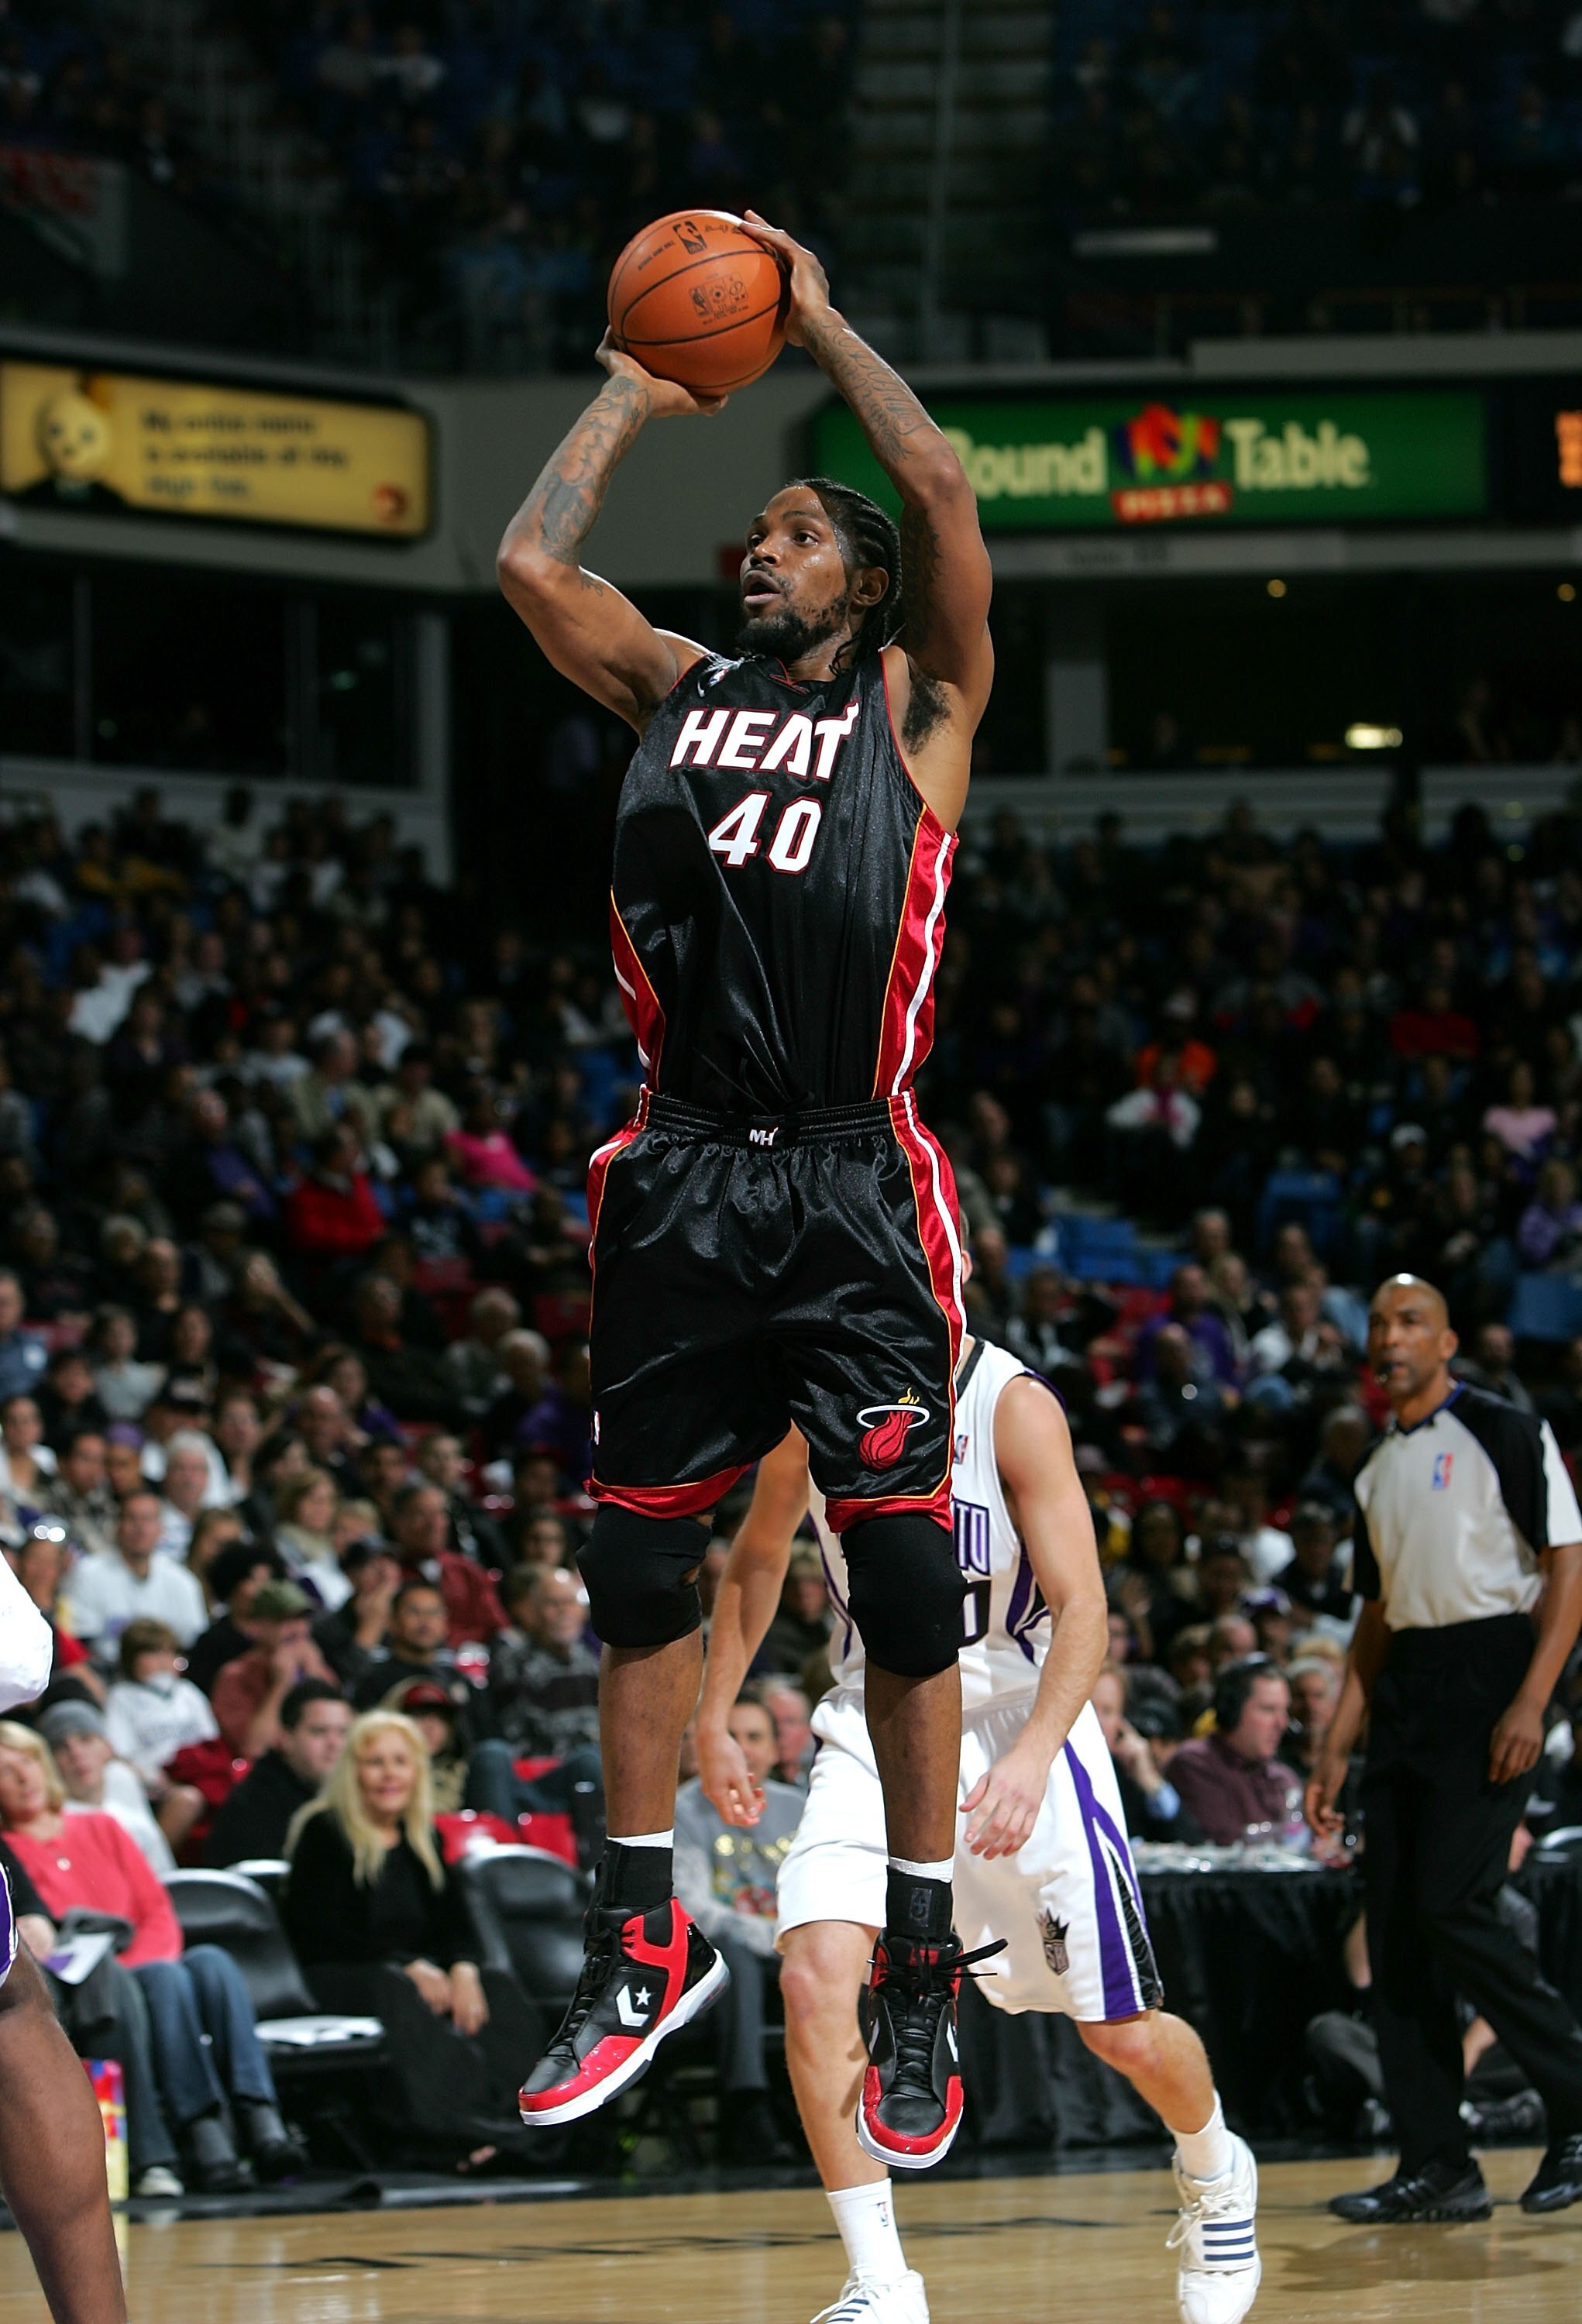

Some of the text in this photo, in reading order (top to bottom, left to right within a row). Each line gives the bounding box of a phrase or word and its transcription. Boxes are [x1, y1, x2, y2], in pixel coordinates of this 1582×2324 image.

[1224, 417, 1370, 490] Table
[668, 696, 859, 782] HEAT
[707, 789, 824, 875] 40
